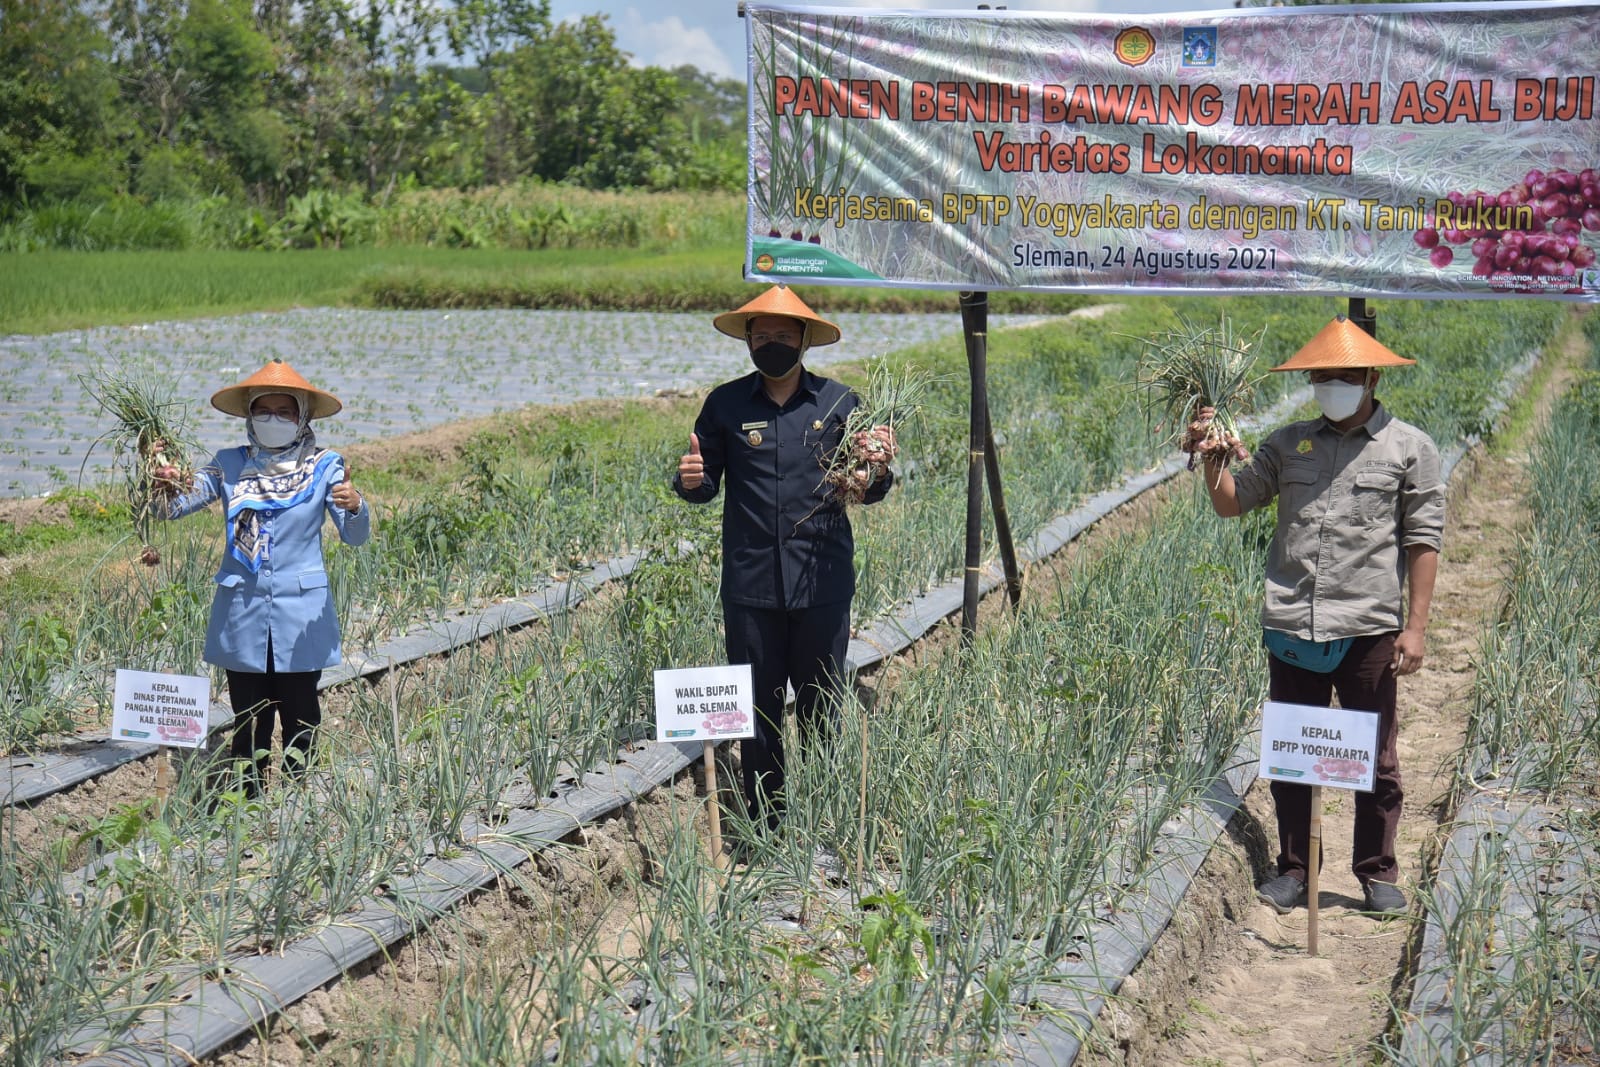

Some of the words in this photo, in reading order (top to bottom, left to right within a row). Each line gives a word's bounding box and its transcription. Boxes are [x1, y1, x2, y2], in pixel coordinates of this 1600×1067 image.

[775, 76, 899, 121] PANEN
[912, 81, 1030, 123] BENIH
[1042, 84, 1224, 126] BAWANG
[1234, 82, 1381, 126] MERAH
[1391, 79, 1500, 124] ASAL
[1513, 76, 1595, 121] BIJI
[974, 131, 1130, 173] Varietas
[1142, 132, 1352, 175] Lokananta
[794, 187, 933, 228] Kerjasama
[943, 194, 1010, 226] BPTP
[1018, 195, 1178, 237] Yogyakarta
[1188, 196, 1297, 239] dengan
[1306, 198, 1350, 231] KT.
[1360, 196, 1425, 231] Tani
[1435, 197, 1533, 231] Rukun
[1013, 244, 1095, 271] Sleman,
[1102, 246, 1125, 268] 24
[1132, 247, 1220, 275] Agustus
[1227, 247, 1276, 270] 2021
[776, 265, 823, 273] KEMENTAN
[152, 683, 179, 693] KEPALA
[675, 687, 704, 699] WAKIL
[706, 685, 738, 696] BUPATI
[133, 692, 154, 702] DINAS
[157, 695, 196, 705] PERTANIAN
[125, 702, 153, 713] PANGAN
[154, 706, 160, 714] &
[162, 707, 204, 718] PERIKANAN
[677, 704, 698, 715] KAB.
[700, 701, 737, 713] SLEMAN
[140, 715, 155, 725] KAB.
[157, 717, 187, 728] SLEMAN
[1301, 726, 1342, 741] KEPALA
[1272, 740, 1298, 753] BPTP
[1301, 743, 1370, 762] YOGYAKARTA
